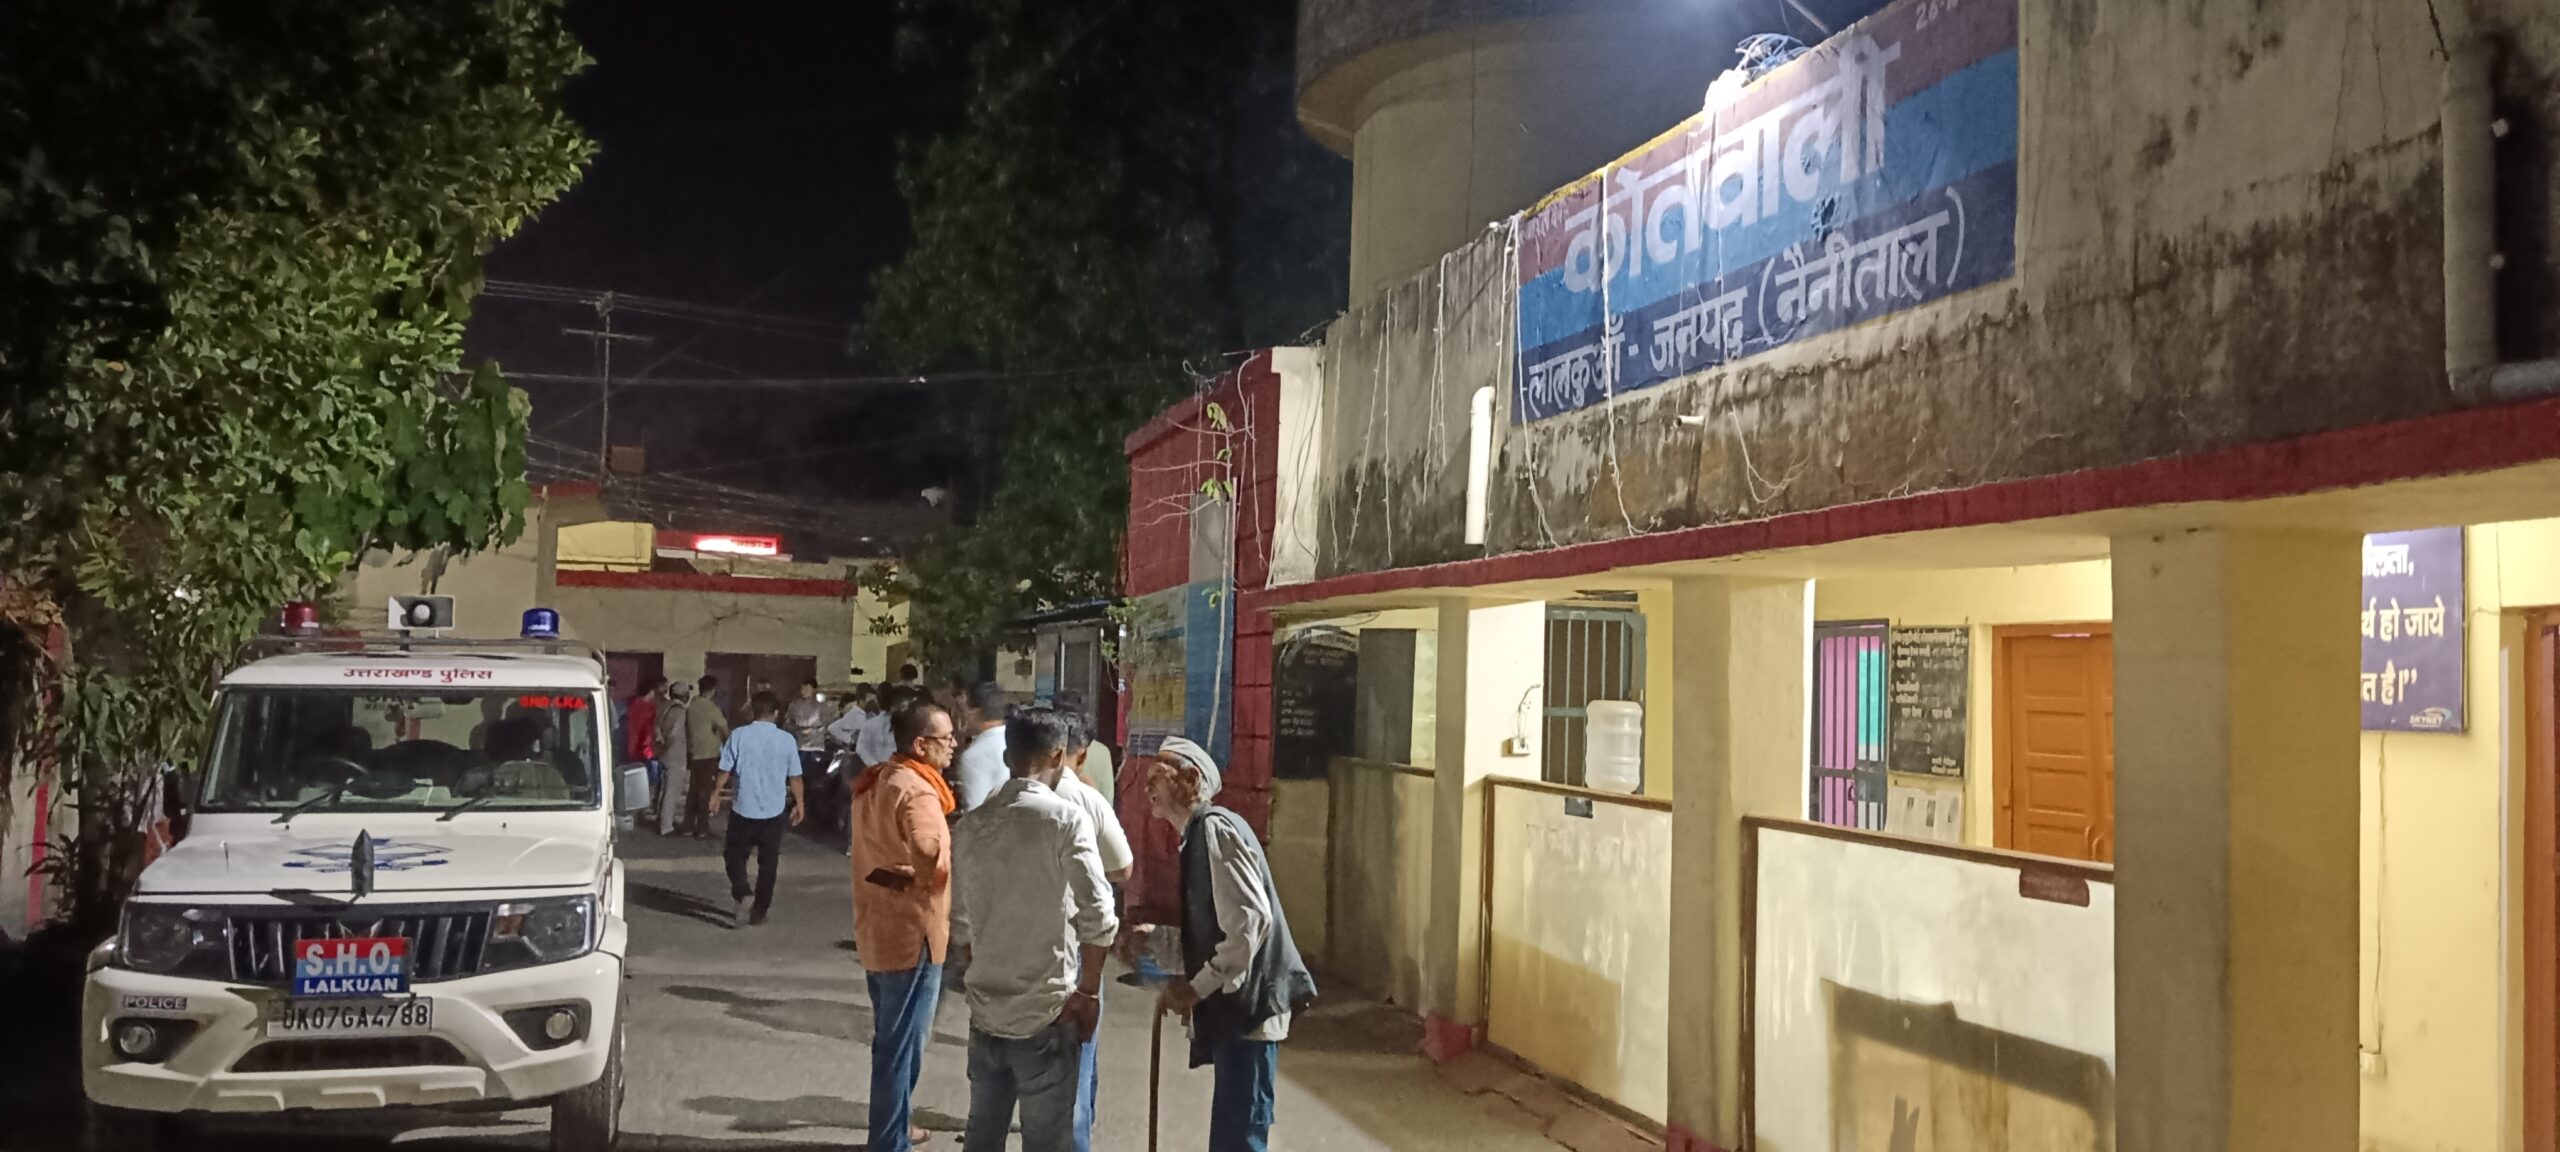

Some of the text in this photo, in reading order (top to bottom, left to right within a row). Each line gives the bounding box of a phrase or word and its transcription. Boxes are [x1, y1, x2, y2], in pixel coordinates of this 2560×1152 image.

[1563, 33, 1902, 295] कोतवाली
[1649, 284, 1745, 361] जनपद
[1757, 186, 1966, 346] (नैनीताल)
[2379, 596, 2401, 642] हो
[2402, 594, 2446, 638] जाये
[343, 667, 493, 683] उत्तराखण्ड पुलिस
[304, 942, 400, 976] S.H.O.
[303, 977, 399, 994] LALKUAN
[124, 996, 185, 1009] POLICE
[282, 1004, 429, 1031] UK07GA4788
